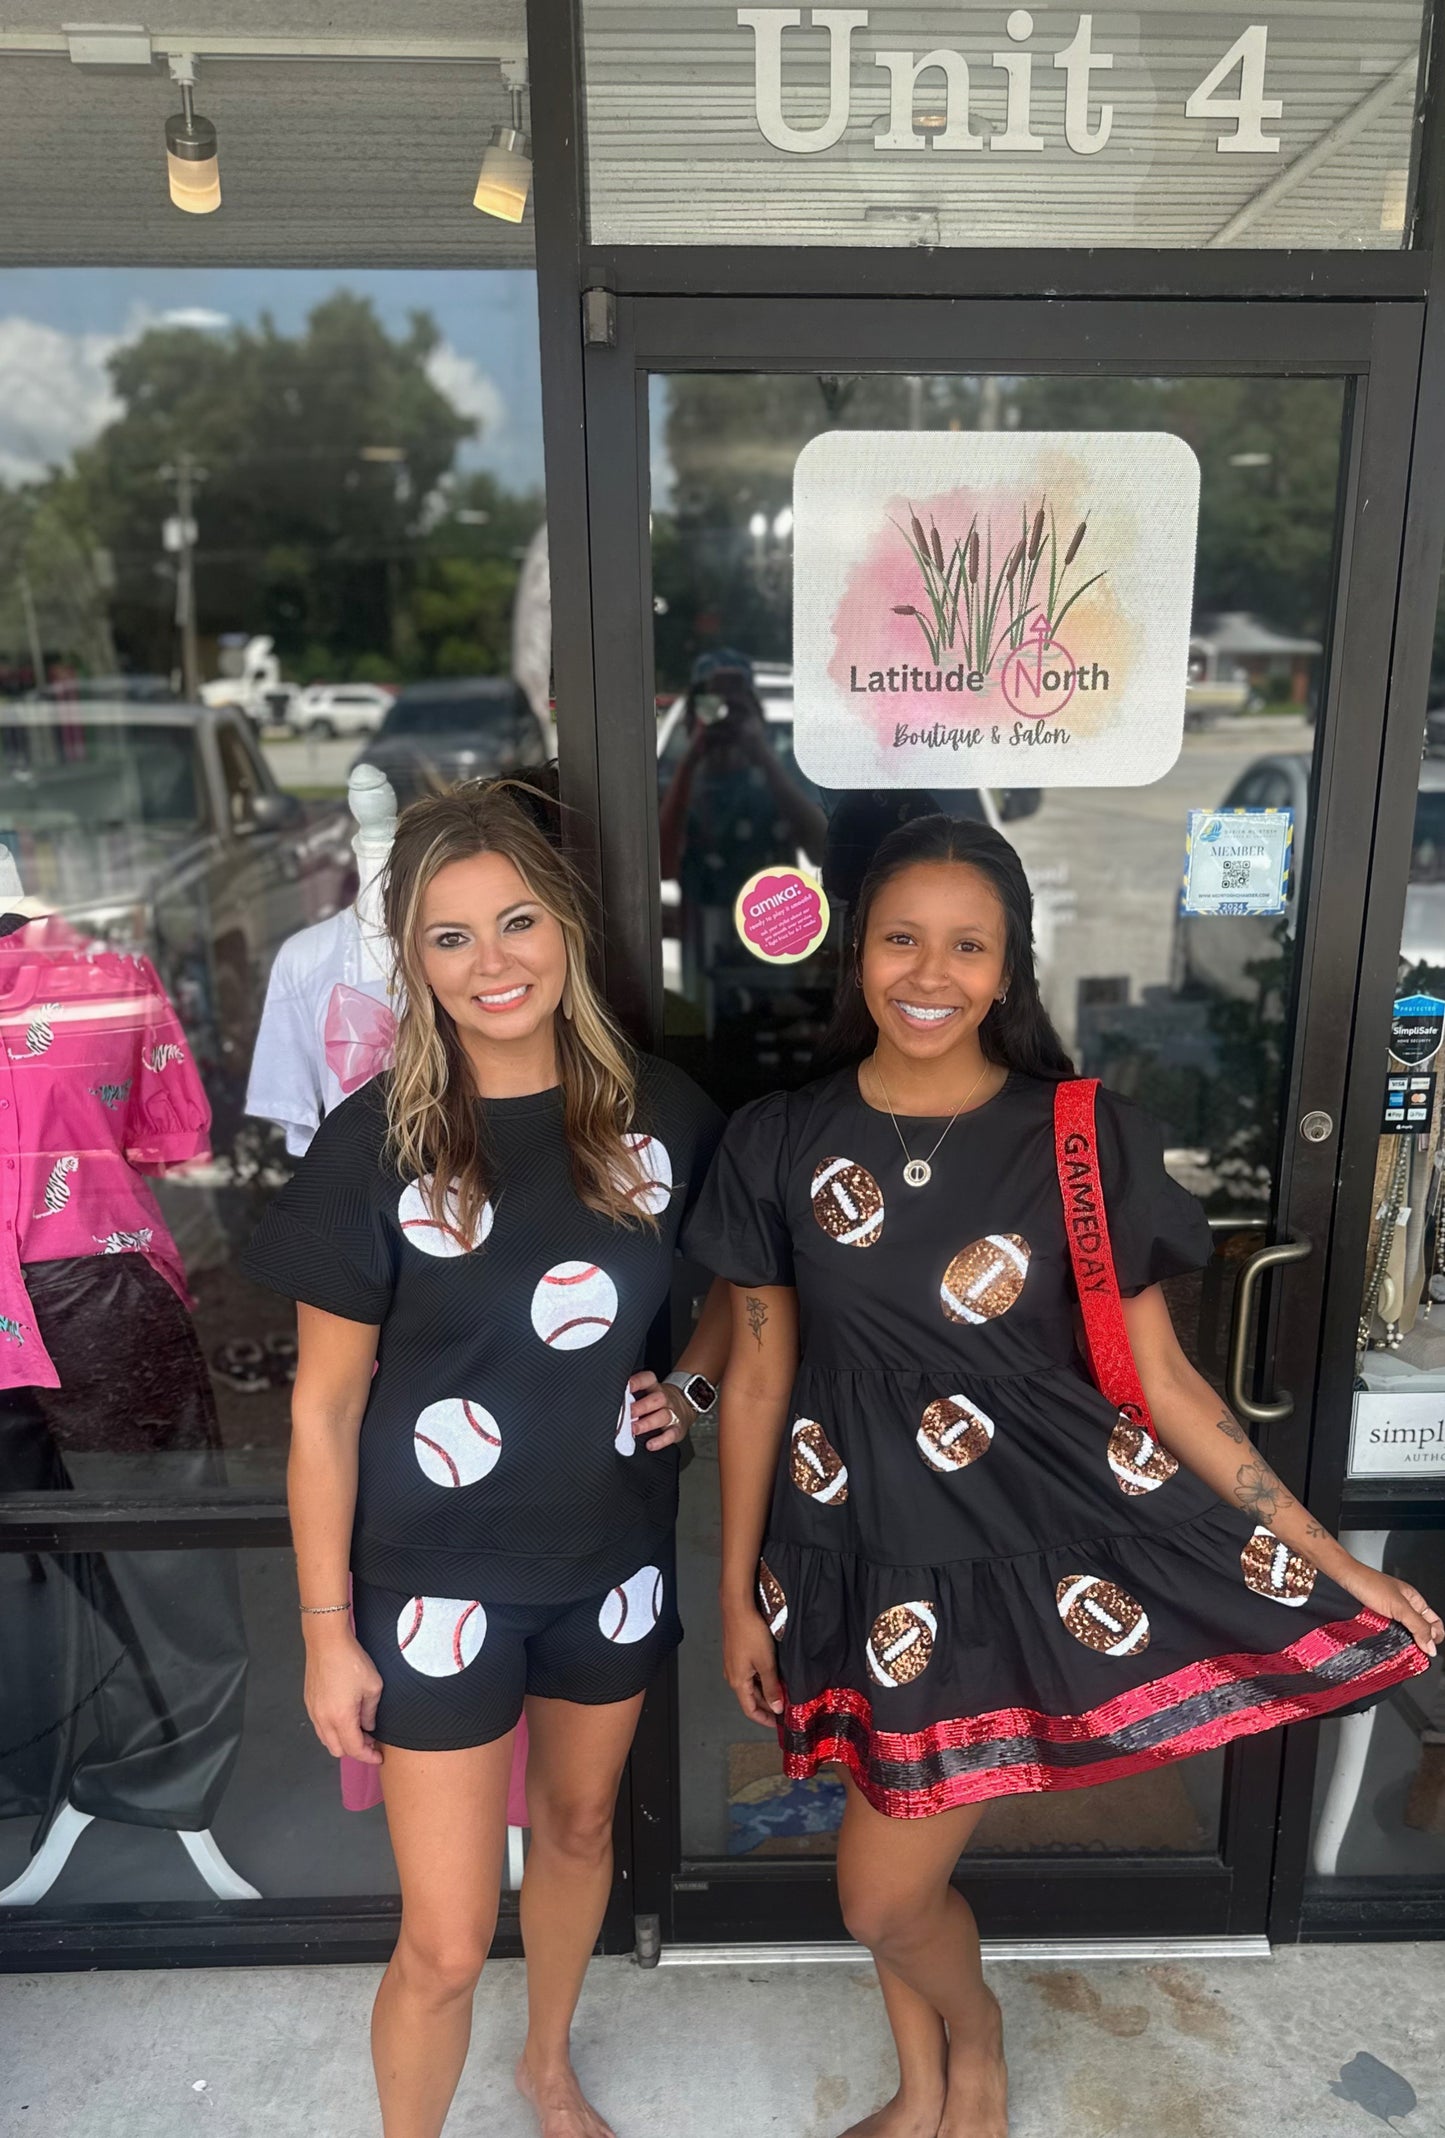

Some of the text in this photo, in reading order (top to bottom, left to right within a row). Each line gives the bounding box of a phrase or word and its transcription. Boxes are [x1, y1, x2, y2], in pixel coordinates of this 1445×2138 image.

[737, 8, 1283, 154] Unit 4
[849, 659, 1110, 699] Latitude North
[892, 720, 1071, 751] Boutique & Salon
[1210, 846, 1265, 857] MEMBER
[749, 883, 802, 918] amika:
[1393, 1026, 1438, 1036] SimpliSafe
[1064, 1132, 1111, 1296] GAMEDAY
